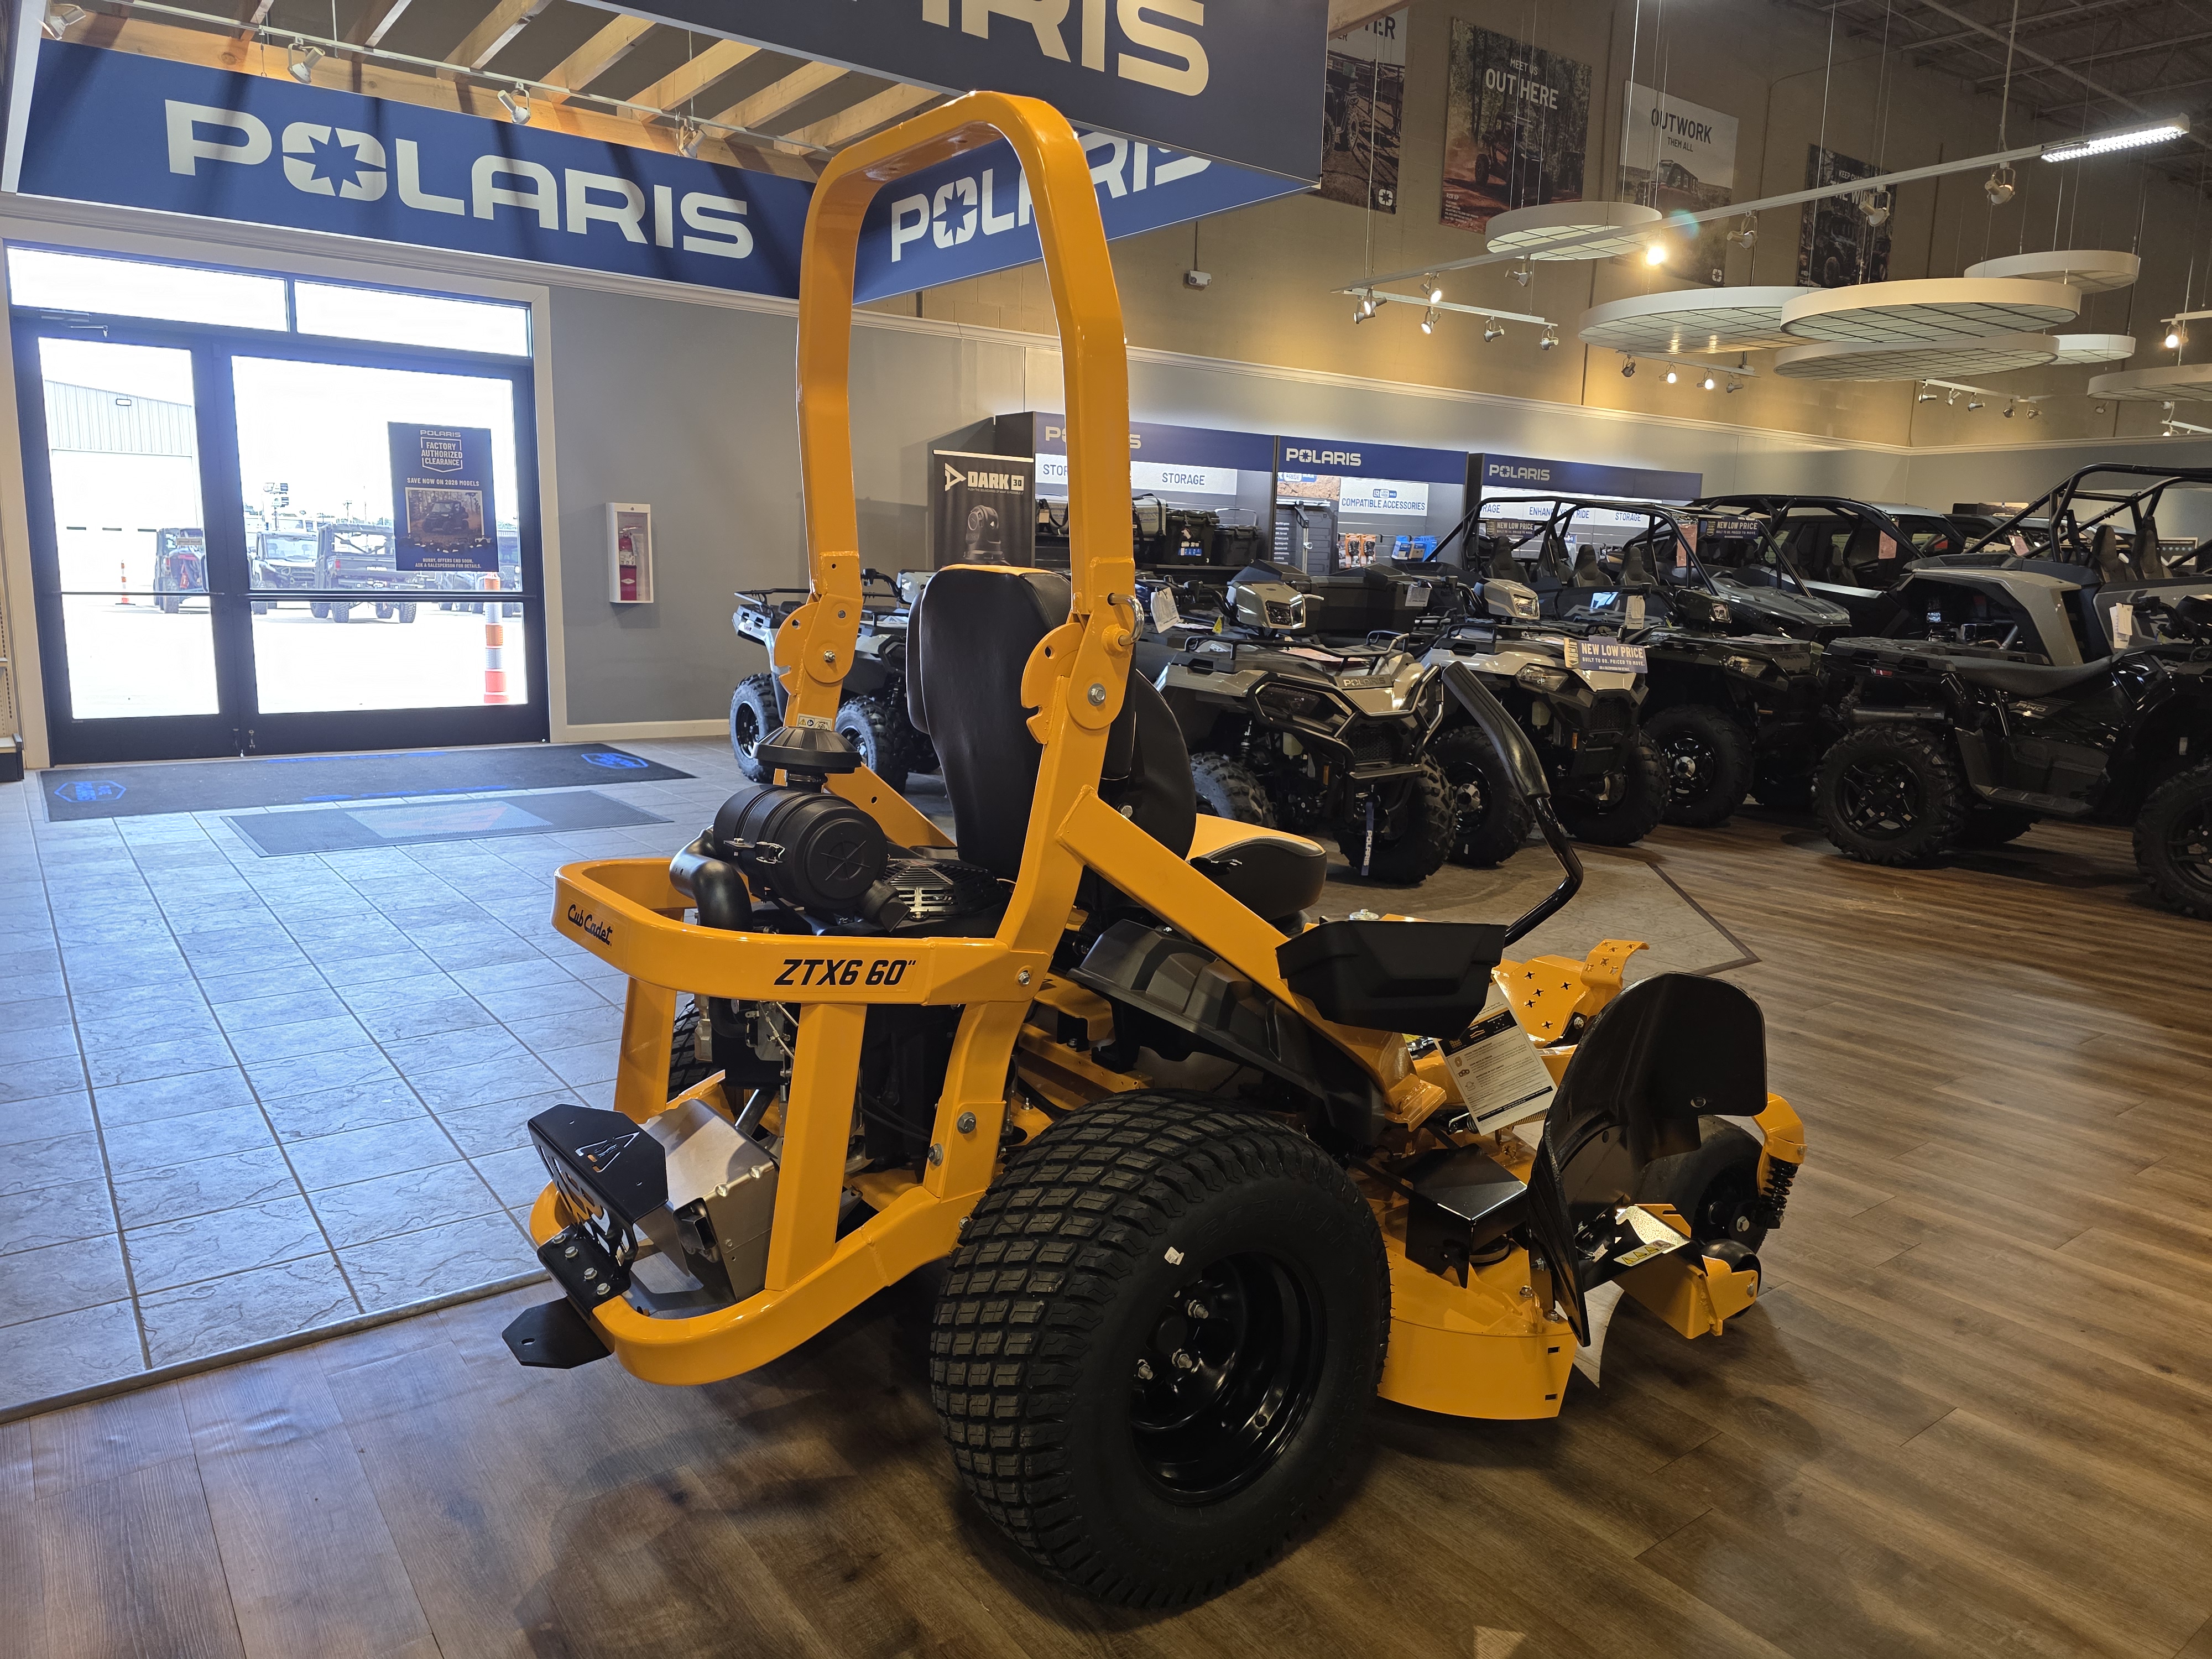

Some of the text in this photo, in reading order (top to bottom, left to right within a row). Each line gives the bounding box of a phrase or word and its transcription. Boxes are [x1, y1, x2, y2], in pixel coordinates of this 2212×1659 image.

[1510, 58, 1538, 76] MEET US
[1486, 68, 1559, 109] OUT HERE
[1651, 108, 1712, 144] OUTWORK
[1668, 137, 1693, 152] THEM ALL
[165, 100, 754, 259] POLARIS
[1839, 169, 1850, 179] KEEP
[421, 450, 463, 458] AUTHORIZED
[426, 442, 456, 451] FACTORY
[425, 457, 460, 466] CLEARANCE
[1286, 448, 1361, 466] POLARIS
[968, 471, 1009, 489] DARK
[1162, 472, 1205, 486] STORAGE
[1489, 464, 1550, 481] POLARIS
[1342, 498, 1425, 510] COMPATIBLE ACCESSORIES
[1576, 510, 1590, 519] RIDE
[1615, 513, 1641, 521] STORAGE
[1582, 643, 1599, 655] NEW
[1601, 645, 1618, 657] LOW
[1620, 646, 1644, 659] PRICE
[1343, 677, 1385, 686] POLARIS
[2016, 702, 2046, 712] AWD
[1363, 830, 1372, 865] POLARIS
[568, 904, 613, 946] Cub Cadet
[774, 959, 916, 985] ZTX6 60"
